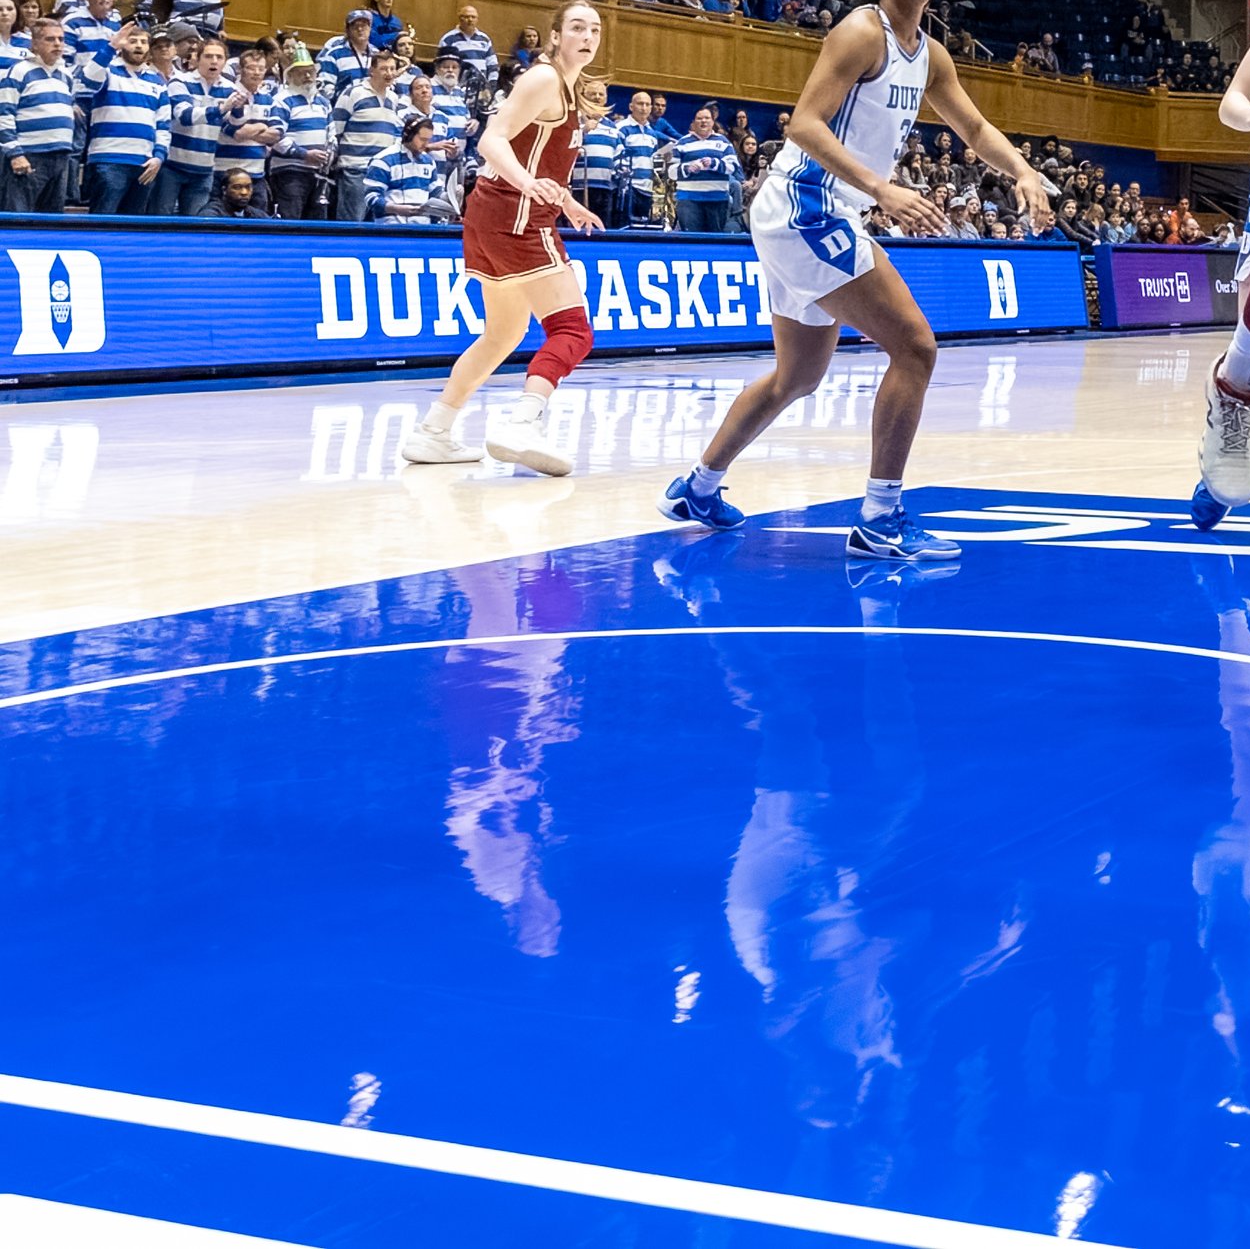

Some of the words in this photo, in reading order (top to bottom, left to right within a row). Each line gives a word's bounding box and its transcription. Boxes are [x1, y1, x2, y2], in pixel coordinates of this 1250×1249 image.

[1138, 278, 1175, 297] TRUIST
[1215, 279, 1230, 294] Over
[312, 256, 486, 341] DUK
